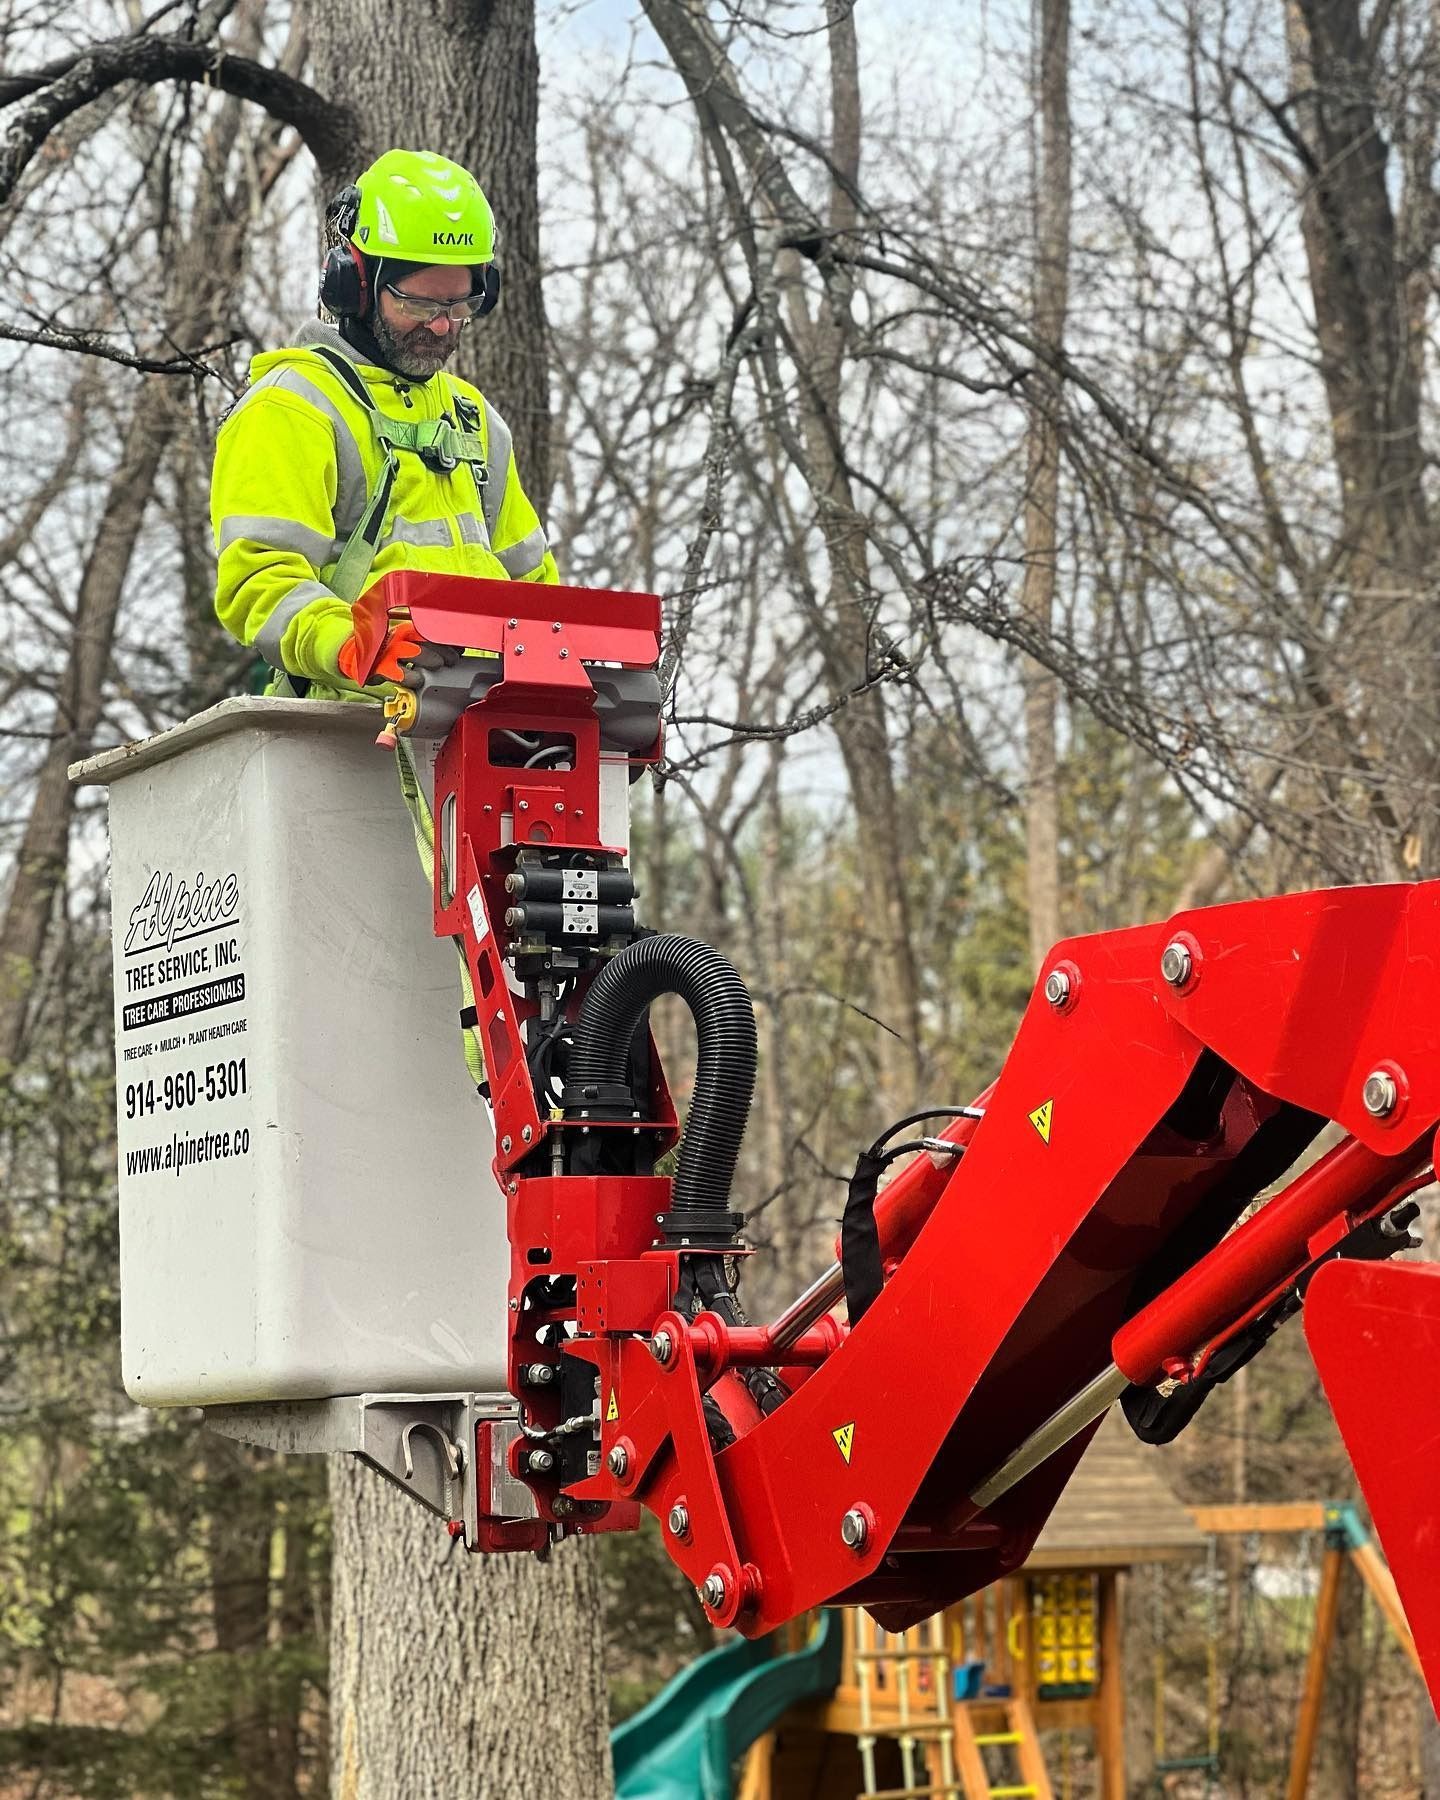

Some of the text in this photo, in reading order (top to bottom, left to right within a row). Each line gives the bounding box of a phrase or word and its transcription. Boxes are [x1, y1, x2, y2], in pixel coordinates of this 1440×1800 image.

[433, 232, 474, 246] KASK
[124, 871, 239, 953] Alpine
[125, 938, 241, 993] TREE SERVICE, INC.
[124, 978, 243, 1027] TREE CARE PROFESSIONALS
[124, 1018, 248, 1062] TREE CARE MULCH PLANT HEALTH CARE
[126, 1057, 248, 1120] 914-960-5301
[126, 1128, 250, 1177] www.alpinetree.co
